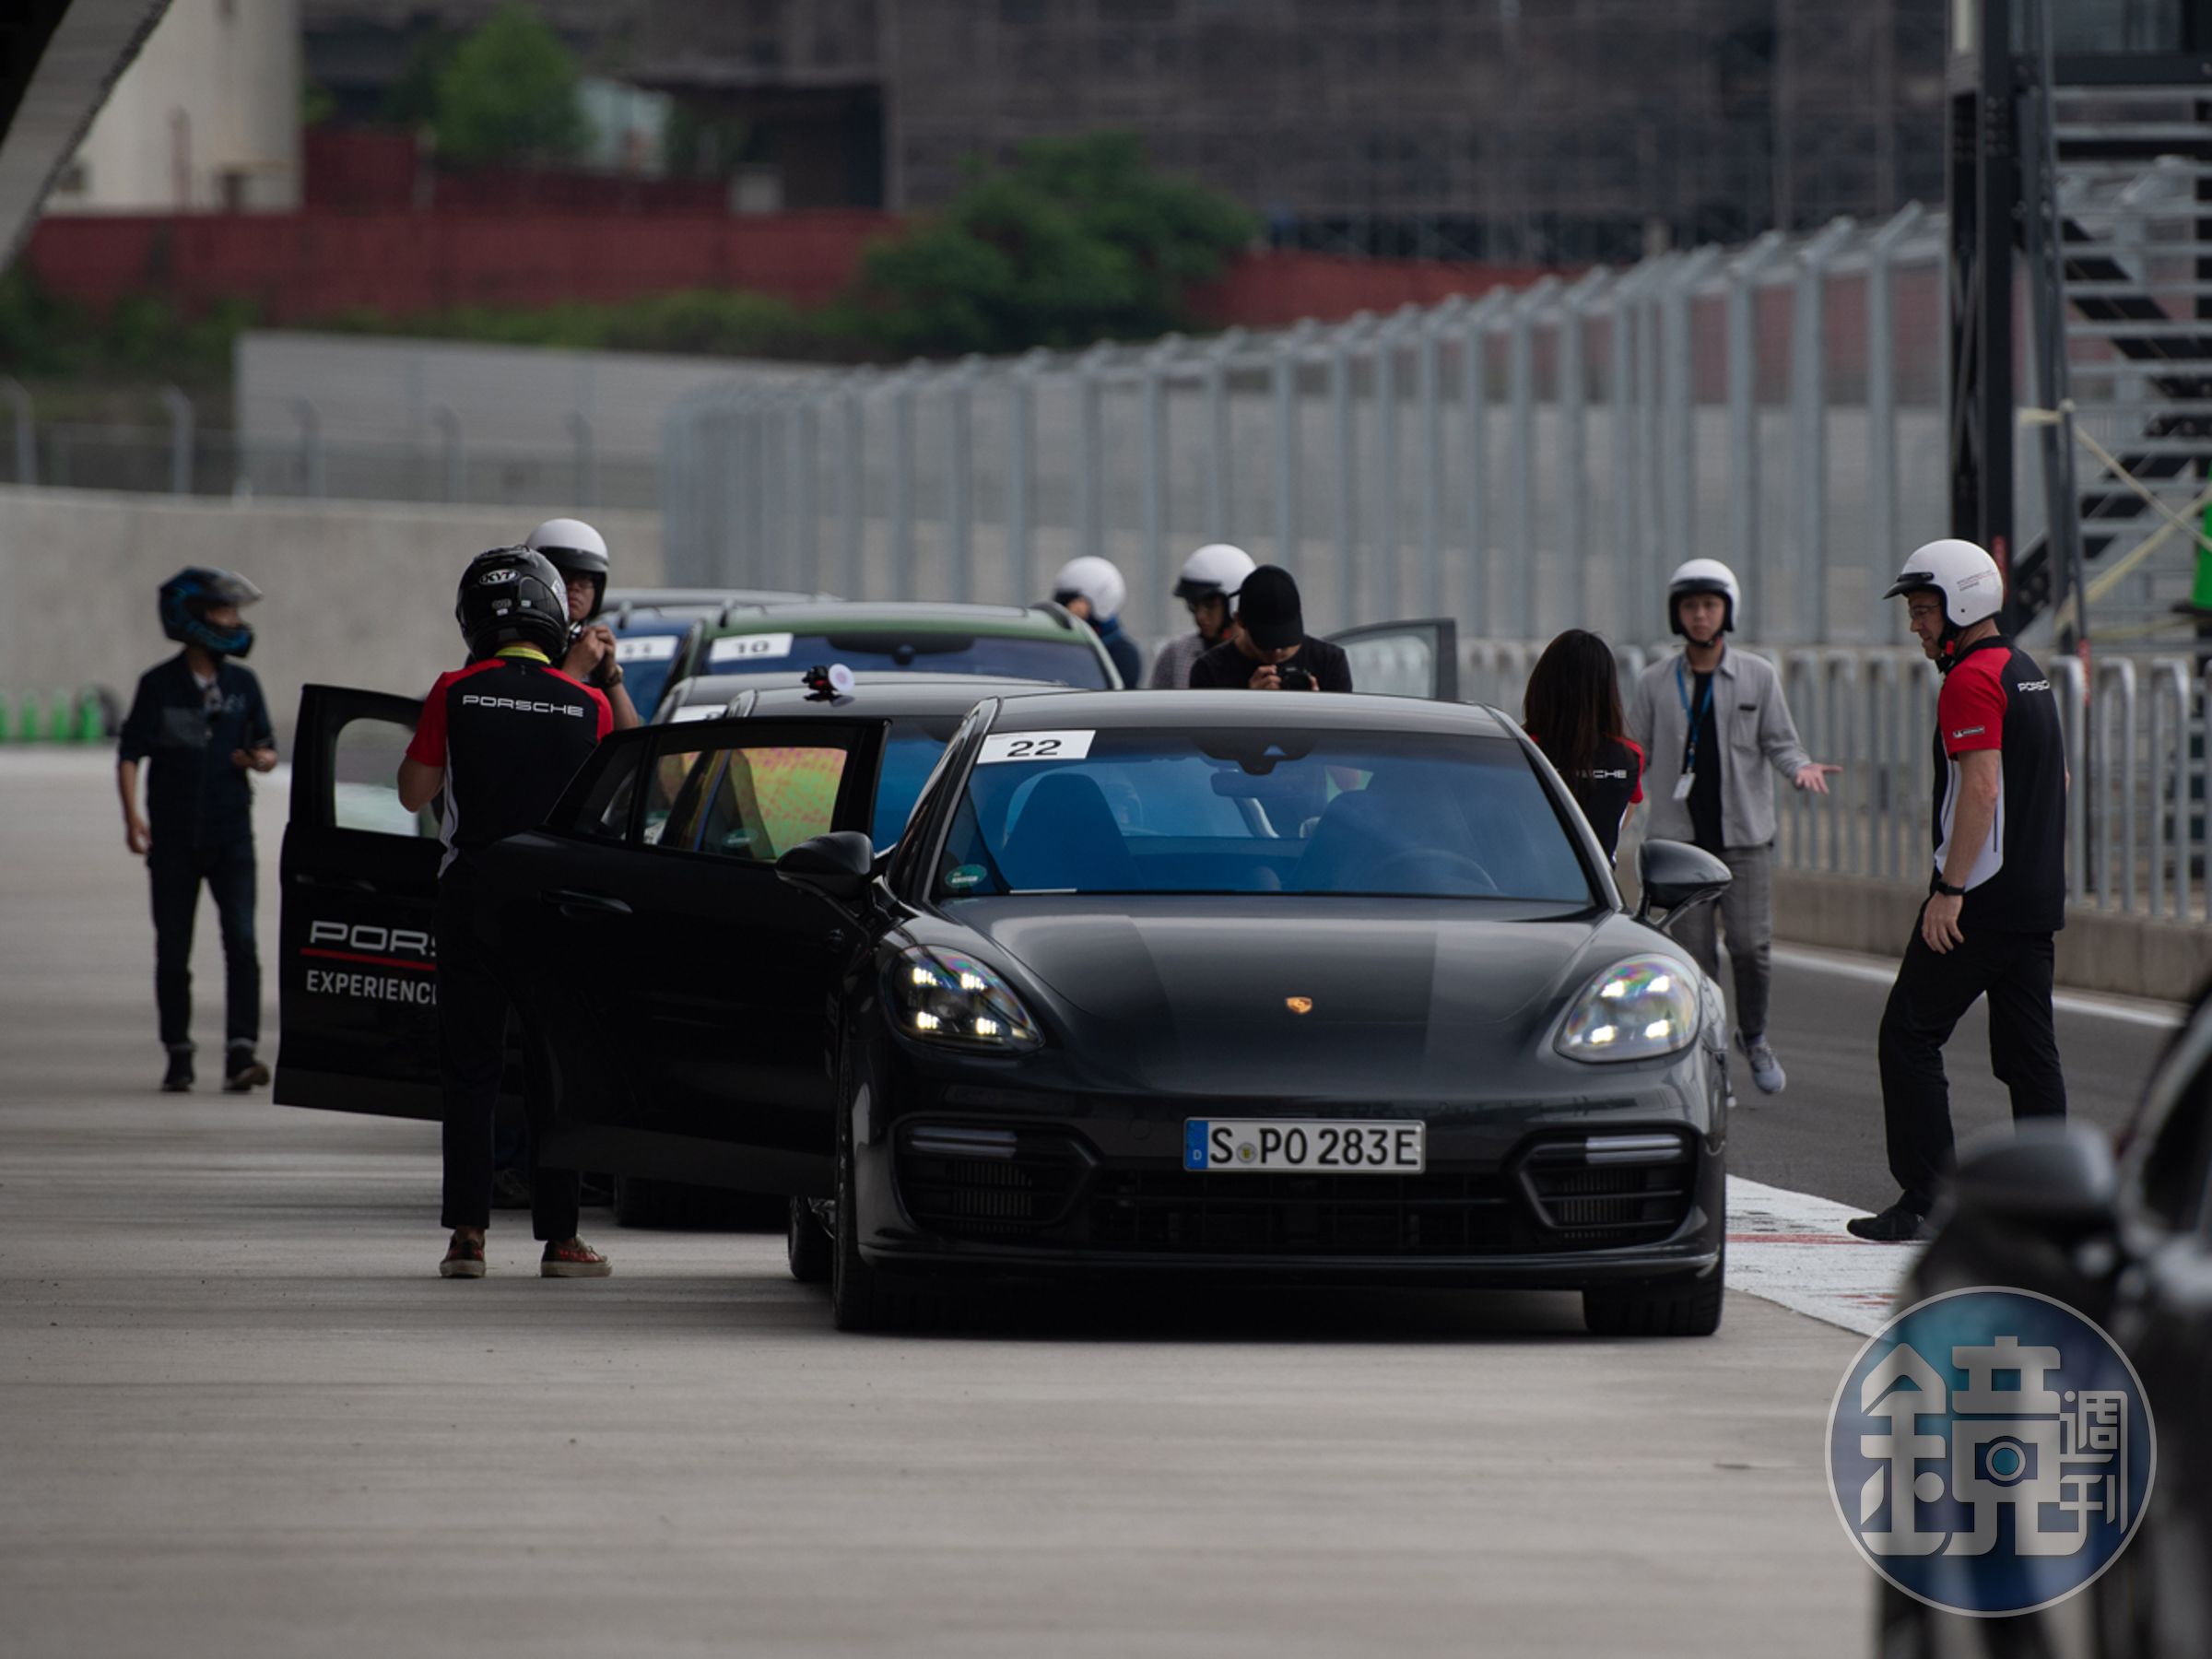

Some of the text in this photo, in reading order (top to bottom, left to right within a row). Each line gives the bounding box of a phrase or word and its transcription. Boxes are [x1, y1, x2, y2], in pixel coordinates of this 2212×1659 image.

[736, 640, 770, 654] 10
[463, 695, 583, 717] PORSCHE
[1006, 739, 1062, 758] 22
[1582, 770, 1627, 779] CHE
[310, 920, 436, 957] POR
[1210, 1126, 1233, 1164] S
[1259, 1127, 1307, 1164] PO
[1318, 1128, 1418, 1165] 283E
